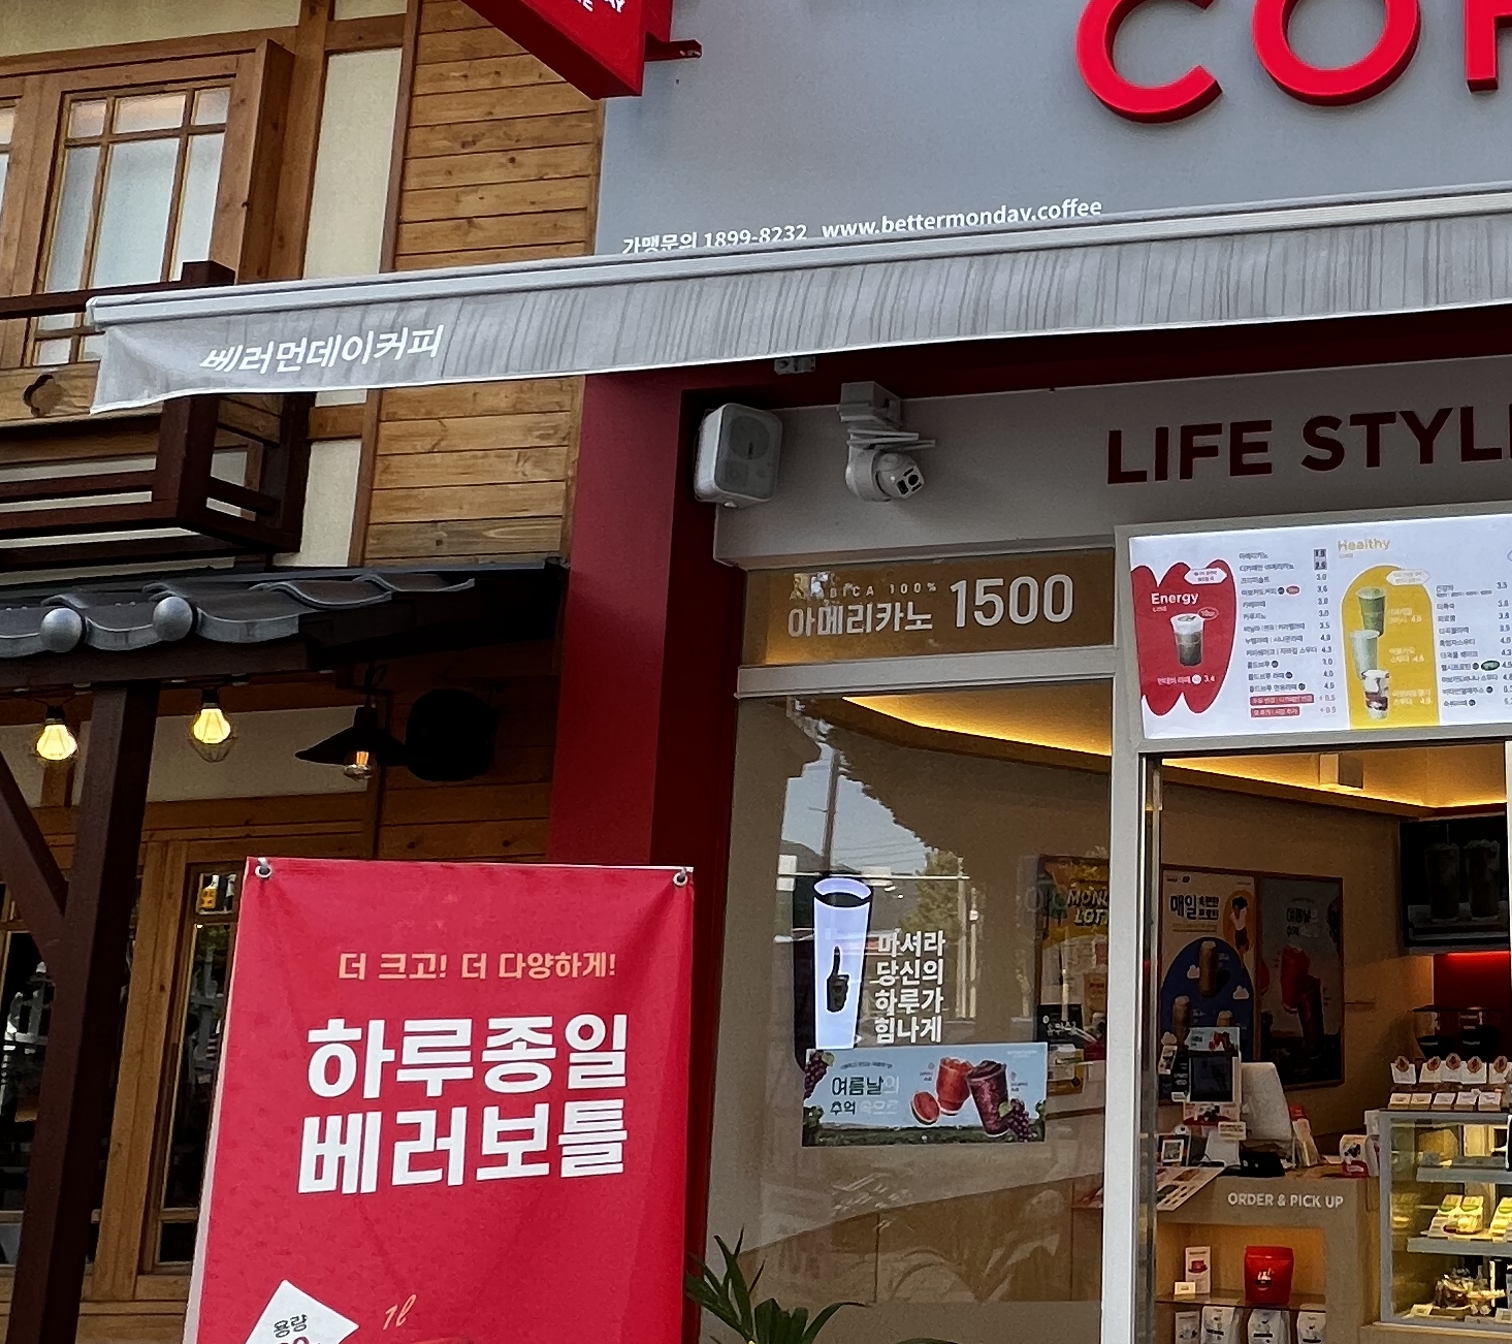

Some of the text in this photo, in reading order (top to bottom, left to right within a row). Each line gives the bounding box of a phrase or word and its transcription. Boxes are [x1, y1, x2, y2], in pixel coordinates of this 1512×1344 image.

[703, 224, 808, 249] 1899-8232
[199, 323, 445, 375] 베러먼데이커피
[1106, 418, 1274, 485] LIFE
[1337, 537, 1391, 554] Healthy
[787, 573, 1074, 638] 아메리카노 1500
[1150, 590, 1200, 608] Energy
[876, 928, 946, 957] 마셔라
[338, 950, 617, 981] 더 크고! 더 다양하게!
[875, 958, 945, 986] 당신의
[874, 988, 944, 1016] 하루가
[873, 1016, 943, 1044] 힘나게
[306, 1013, 629, 1100] 하루종일
[831, 1074, 900, 1096] 여름날의
[297, 1098, 629, 1196] 베러보틀
[1227, 1191, 1345, 1209] ORDER & PICK UP
[272, 1313, 309, 1339] 용량
